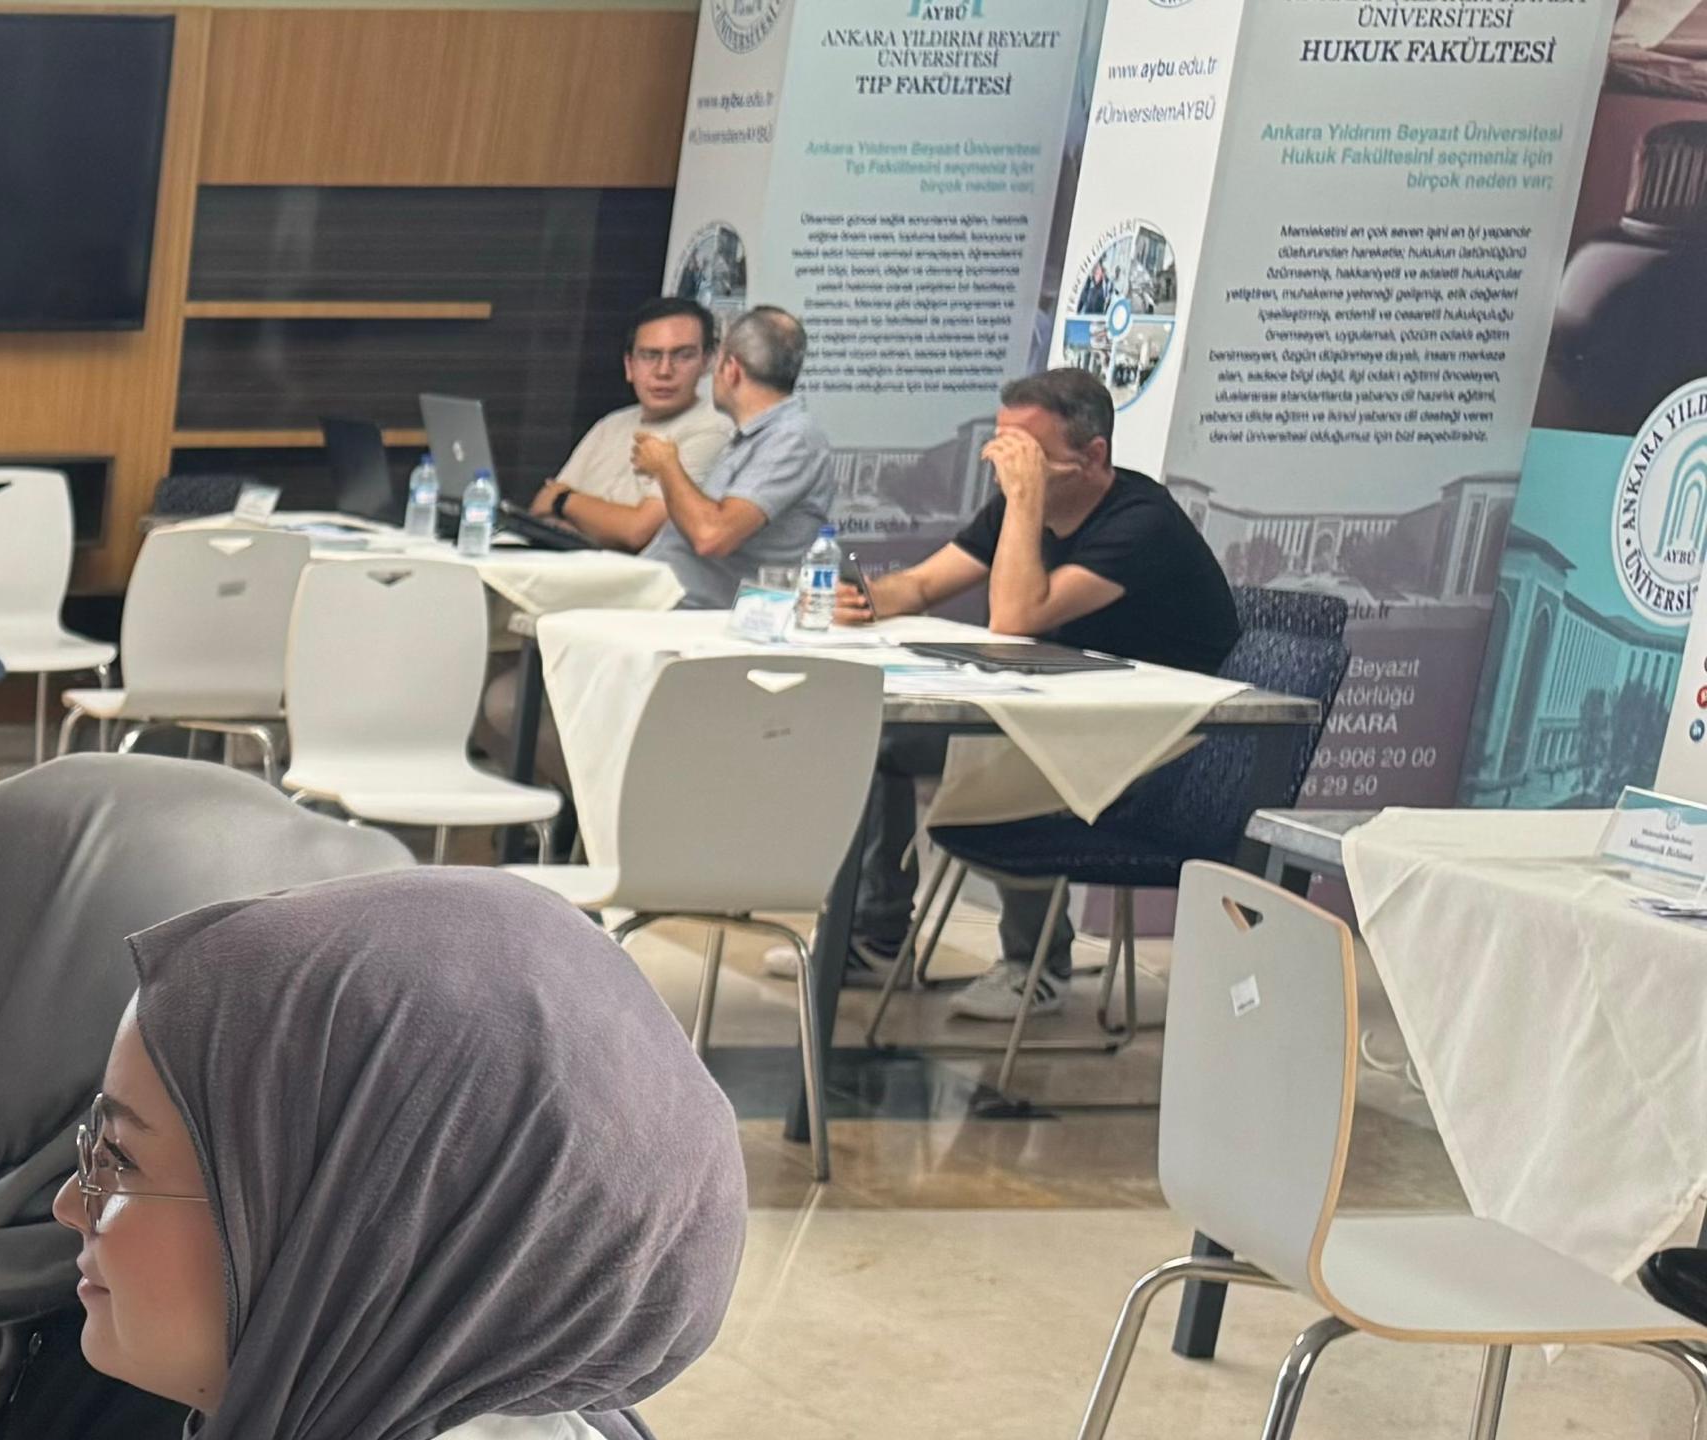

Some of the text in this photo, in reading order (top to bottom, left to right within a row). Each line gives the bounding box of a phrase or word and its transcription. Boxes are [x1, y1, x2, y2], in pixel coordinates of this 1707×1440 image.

[921, 5, 966, 20] AYBÜ
[1357, 3, 1514, 28] ÜNİVERSİTESİ
[822, 30, 1061, 48] ANKARA YILDIRIM BEYAZIT
[1300, 36, 1557, 63] HUKUK FAKÜLTESİ
[877, 48, 1000, 68] ÜNİVERSİTESİ
[1108, 56, 1218, 85] www.aybu.edu.tr
[856, 72, 1012, 95] TIP FAKÜLTESİ
[1095, 96, 1216, 124] #ÜniversitemAYBÜ
[1261, 121, 1564, 143] Ankara Yıldırım Beyazıt Üniversitesi
[1282, 148, 1553, 168] Hukuk Fakültesini seçmeniz için
[1407, 172, 1459, 192] birçok
[1465, 172, 1517, 188] neden
[1622, 430, 1664, 531] ANKARA
[1348, 656, 1420, 682] Beyazıt
[1380, 747, 1406, 768] 20
[1411, 746, 1436, 768] 00
[1322, 775, 1348, 796] 29
[1353, 774, 1378, 796] 50
